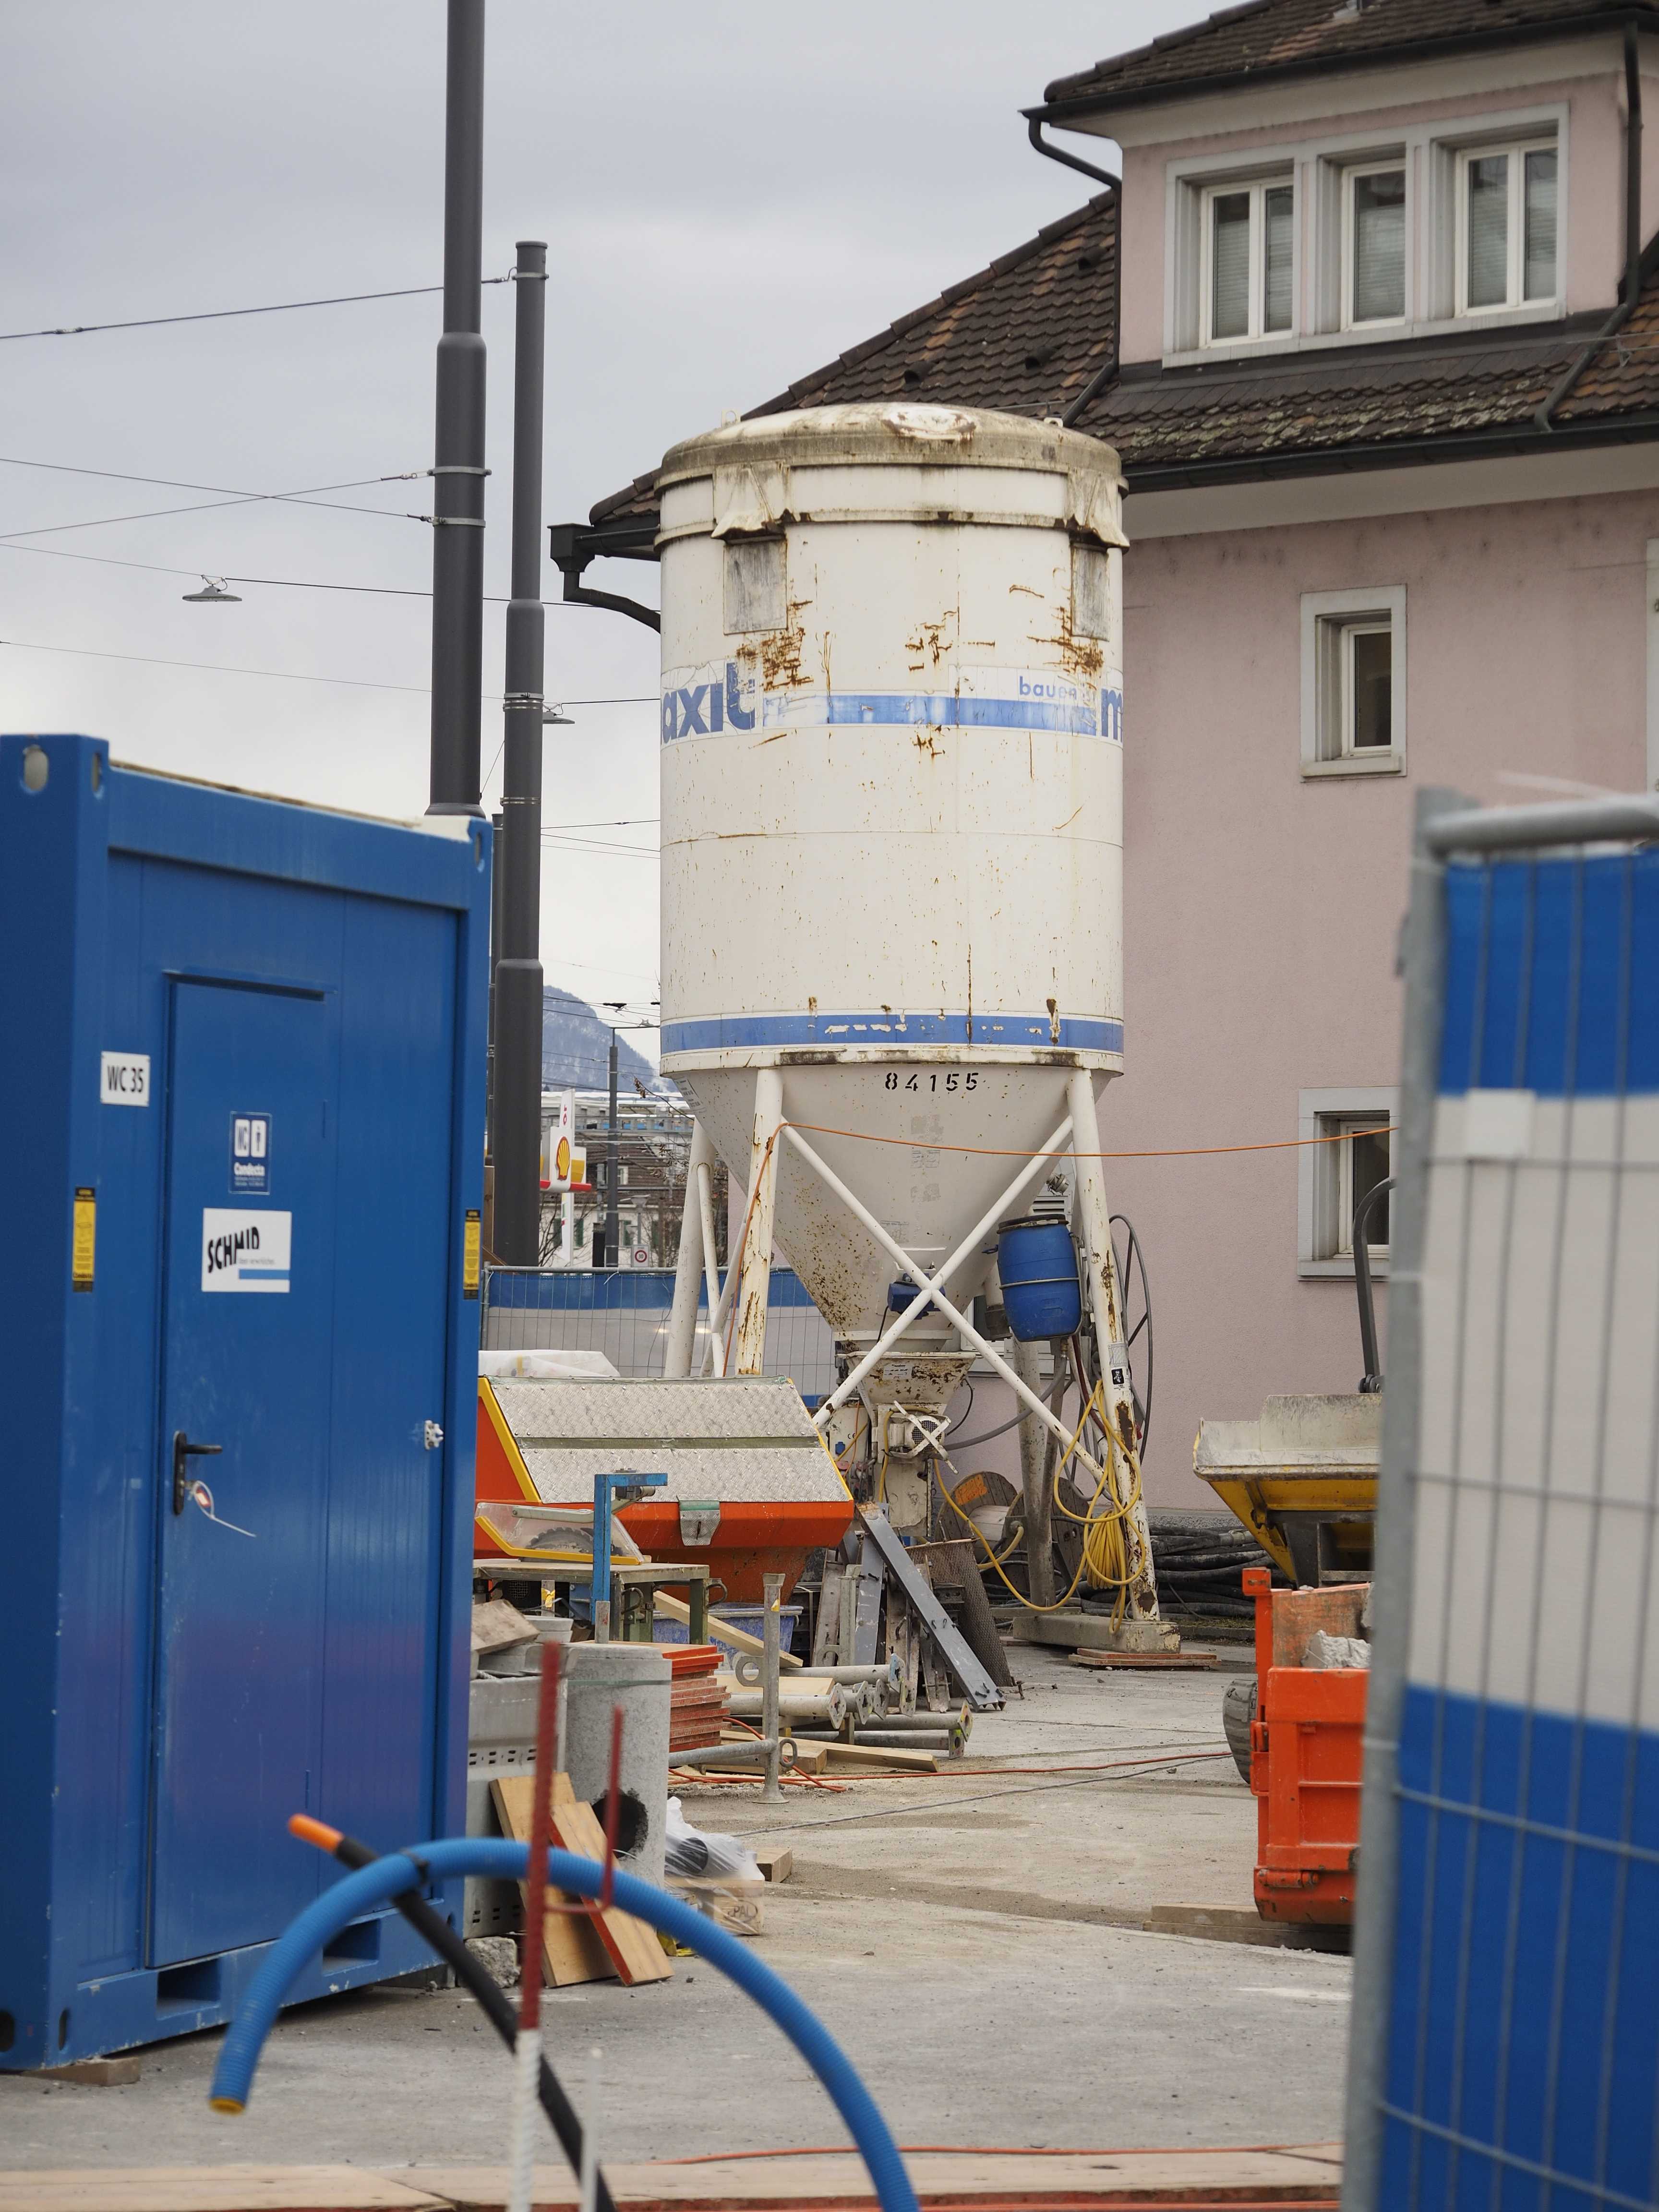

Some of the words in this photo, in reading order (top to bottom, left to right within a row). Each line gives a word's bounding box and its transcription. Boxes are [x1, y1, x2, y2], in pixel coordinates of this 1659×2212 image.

[1020, 676, 1077, 700] bauen
[107, 1065, 126, 1092] WC
[131, 1067, 144, 1093] 35
[885, 1072, 979, 1092] 84155
[207, 1226, 260, 1274] SCHMID
